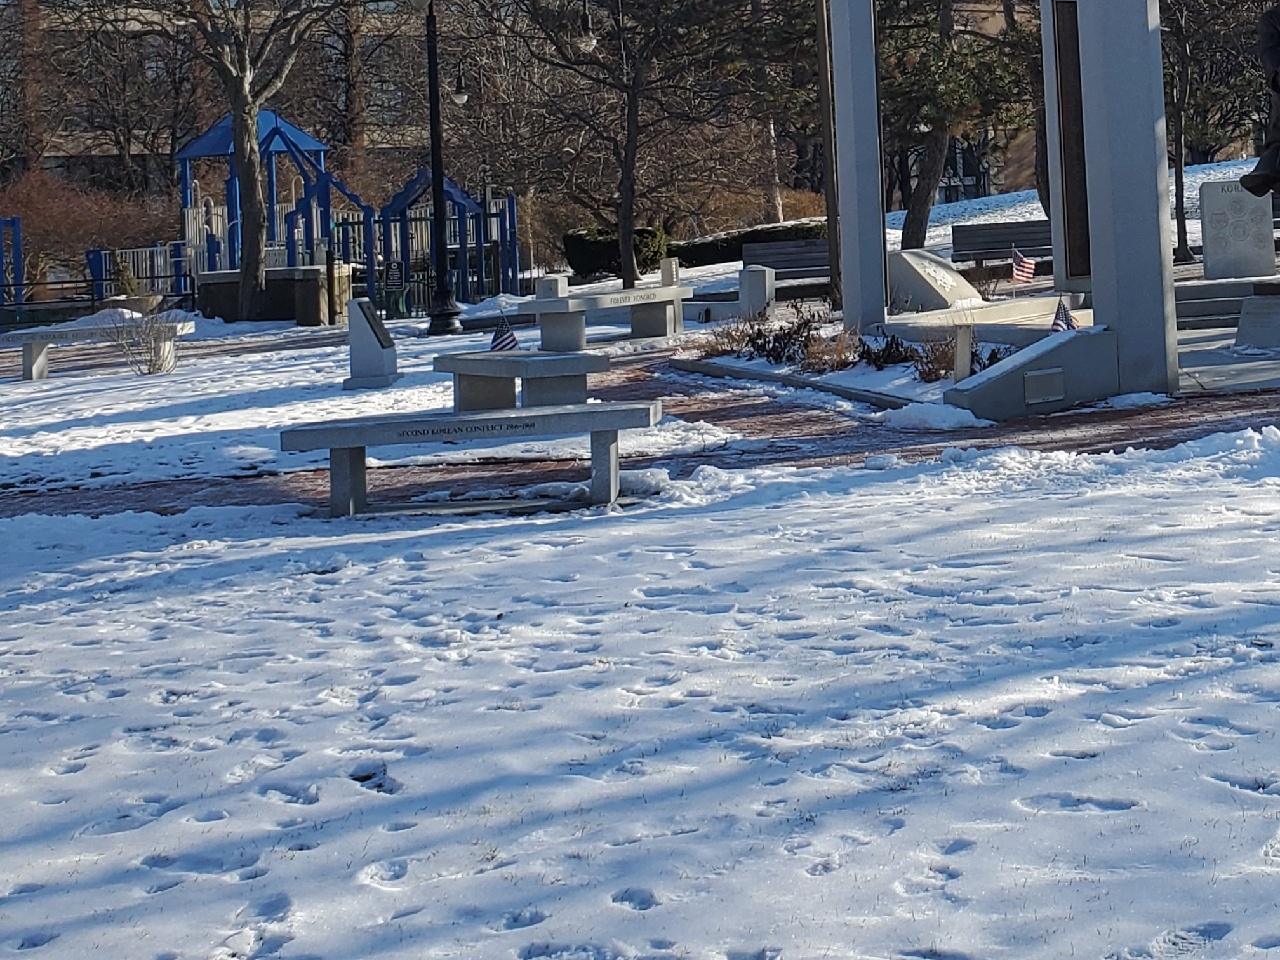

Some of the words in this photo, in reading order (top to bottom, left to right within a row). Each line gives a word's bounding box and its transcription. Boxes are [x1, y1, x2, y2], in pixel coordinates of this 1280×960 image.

[1221, 184, 1244, 193] KORE
[397, 429, 430, 438] SECOND
[431, 426, 464, 436] KOREAN
[465, 423, 503, 433] CONFLICT
